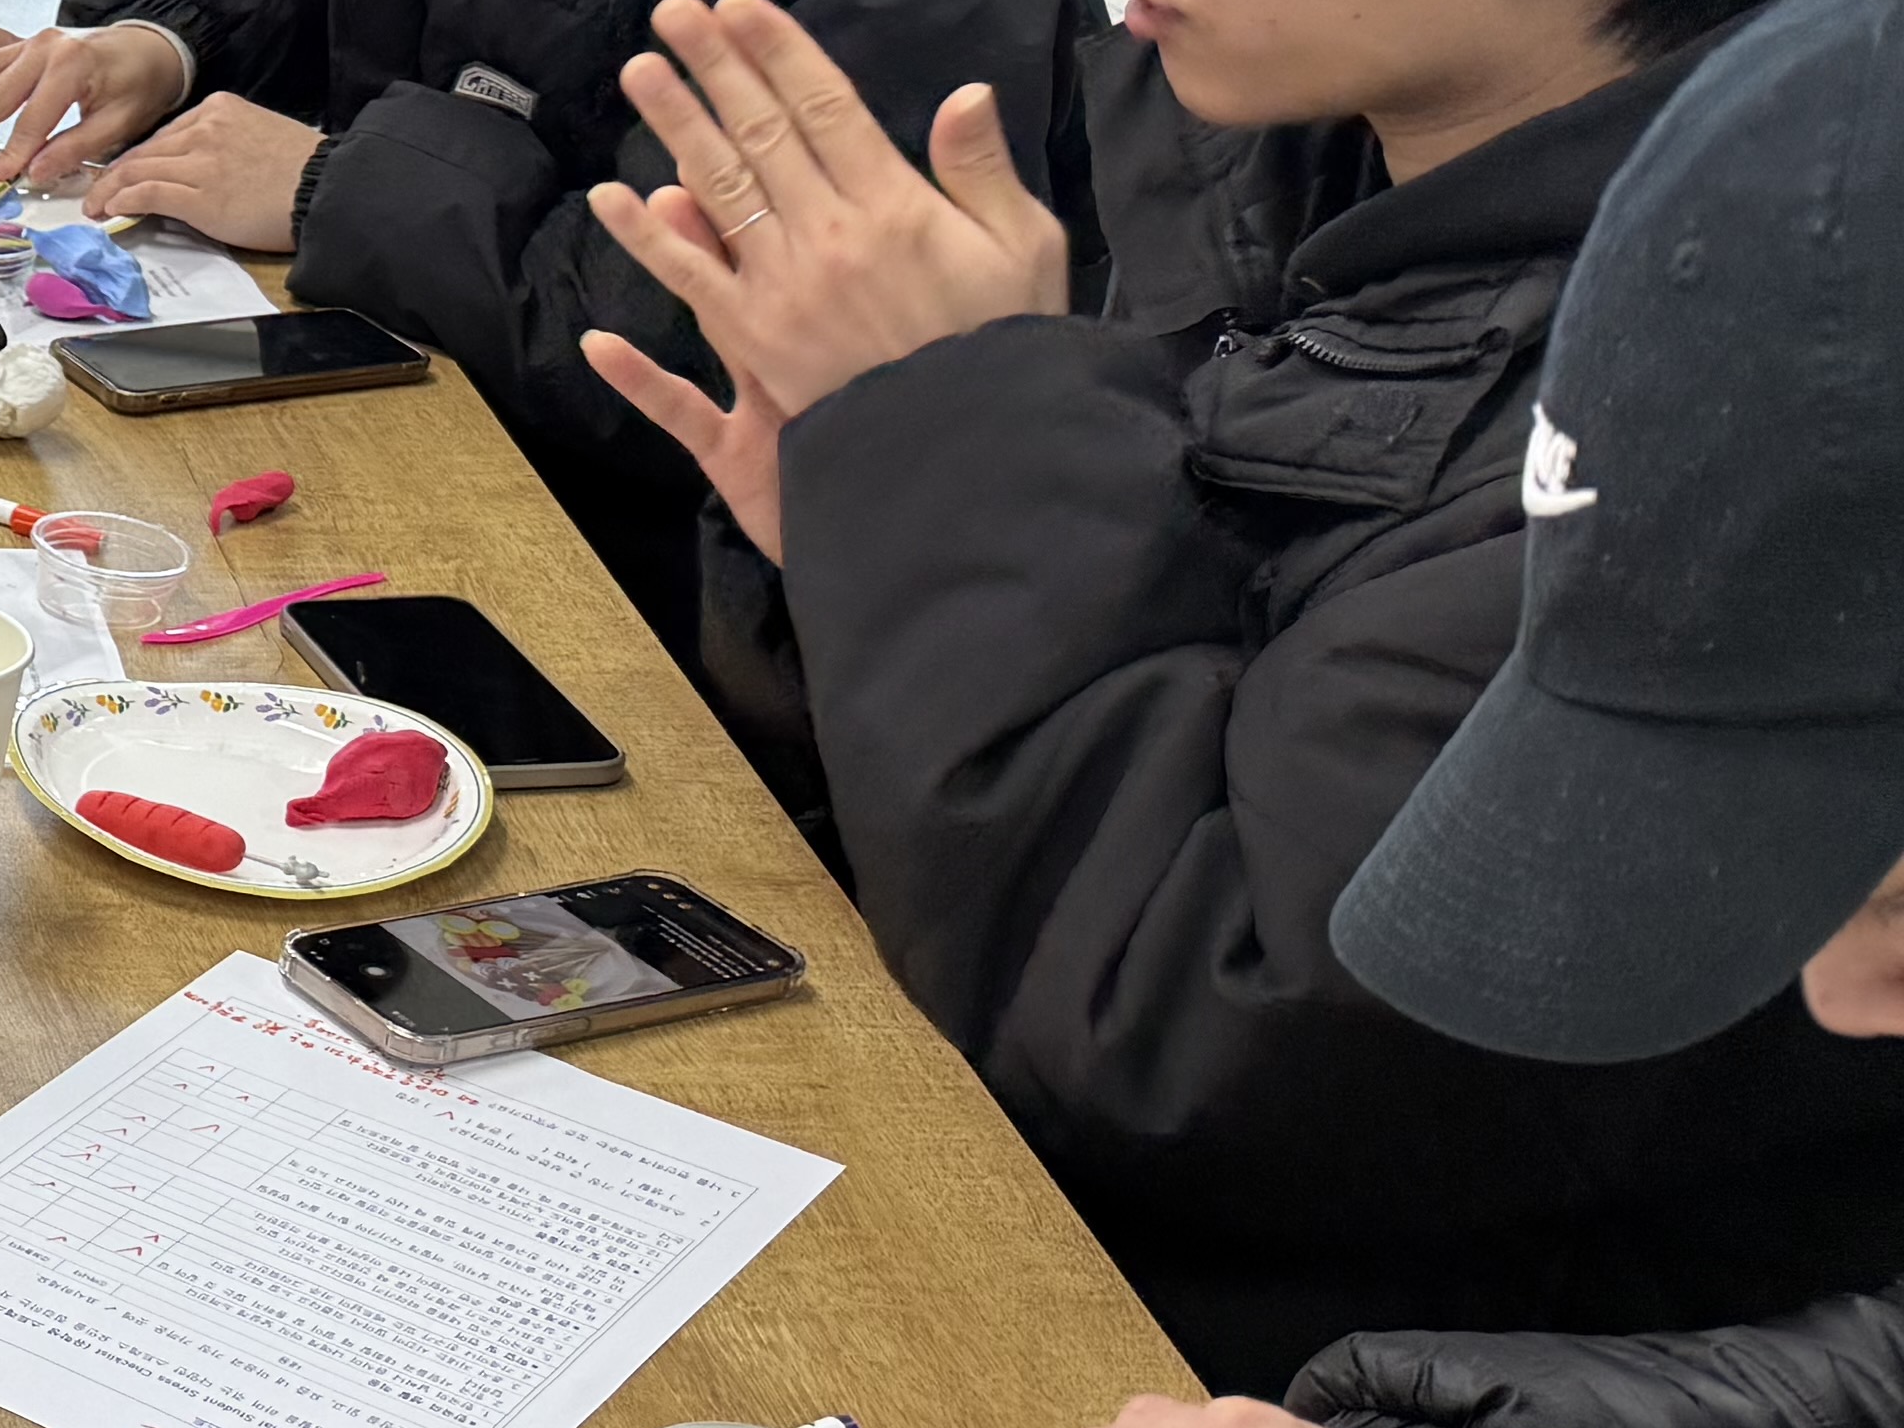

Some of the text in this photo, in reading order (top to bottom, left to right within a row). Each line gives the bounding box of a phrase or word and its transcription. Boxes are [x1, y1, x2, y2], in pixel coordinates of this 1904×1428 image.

[94, 1348, 152, 1377] Checklist
[157, 1374, 199, 1397] Stress
[202, 1395, 255, 1422] Student
